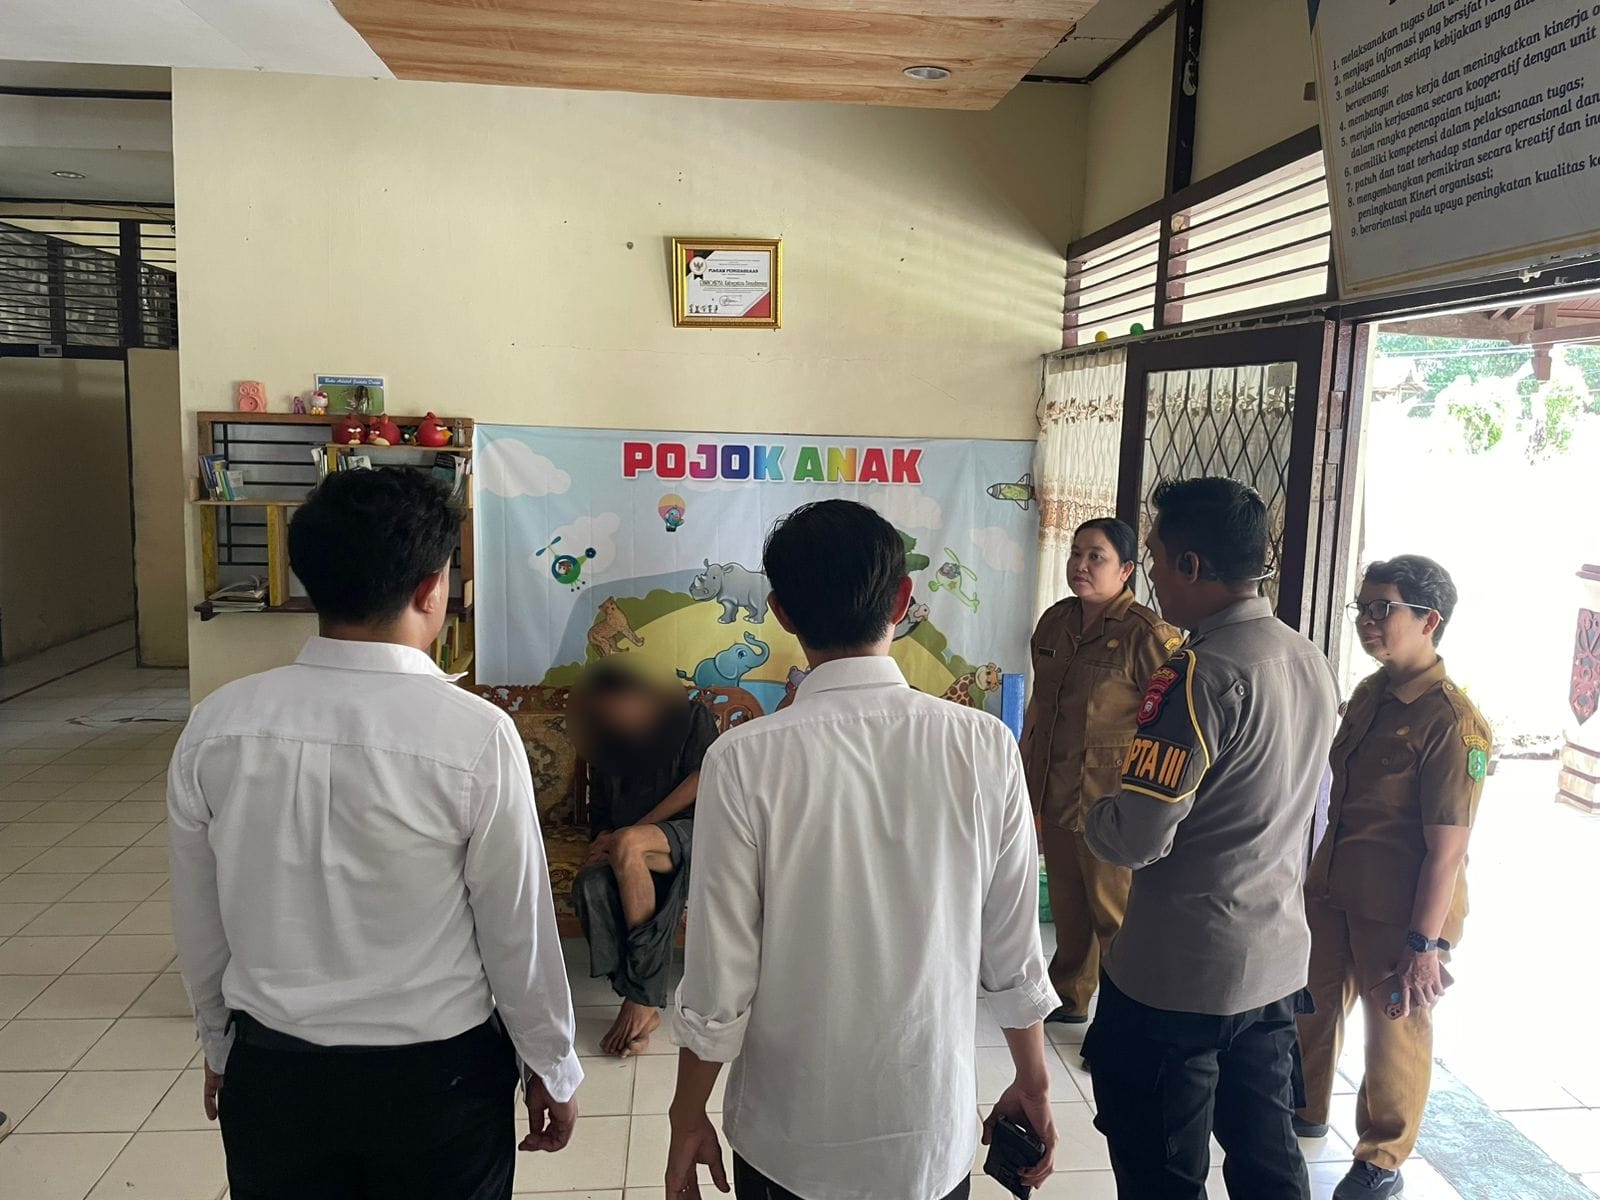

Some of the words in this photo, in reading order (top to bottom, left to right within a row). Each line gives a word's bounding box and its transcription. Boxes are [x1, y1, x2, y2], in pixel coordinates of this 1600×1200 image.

[1341, 26, 1399, 66] melaksanakan
[1400, 11, 1425, 32] tugas
[1427, 1, 1446, 18] dan
[1342, 58, 1375, 82] menjaga
[1376, 32, 1417, 63] informasi
[1418, 21, 1441, 43] yang
[1443, 0, 1482, 27] bersifat
[1344, 60, 1402, 97] melaksanakan
[1403, 45, 1432, 66] setiap
[1434, 20, 1482, 51] kebijakan
[1484, 5, 1511, 28] yang
[1347, 100, 1394, 128] membangun
[1396, 90, 1414, 105] etos
[1415, 78, 1440, 97] kerja
[1441, 69, 1461, 84] dan
[1463, 32, 1541, 75] meningkatkan
[1544, 9, 1590, 38] kinerja
[1345, 84, 1389, 113] berwenang;
[1349, 121, 1383, 144] menjalin
[1384, 102, 1430, 128] kerjasama
[1431, 87, 1464, 108] secara
[1465, 57, 1522, 93] kooperatif
[1523, 41, 1567, 68] dengan
[1569, 25, 1598, 48] unit
[1351, 142, 1375, 159] dalam
[1377, 129, 1407, 146] rangka
[1408, 105, 1462, 138] pencapaian
[1464, 89, 1501, 112] tujuan;
[1353, 149, 1387, 175] memiliki
[1388, 131, 1438, 160] kompetensi
[1440, 122, 1471, 141] dalam
[1473, 93, 1544, 131] pelaksanaan
[1546, 77, 1585, 100] tugas;
[1355, 172, 1378, 192] patuh
[1379, 167, 1395, 180] dan
[1397, 160, 1415, 175] taat
[1417, 143, 1460, 166] terhadap
[1462, 127, 1503, 150] standar
[1505, 99, 1573, 136] operasional
[1575, 92, 1600, 109] dan
[1356, 174, 1424, 204] mengembangkan
[1426, 157, 1475, 183] pemikiran
[1477, 143, 1512, 164] secara
[1515, 125, 1555, 151] kreatif
[1557, 120, 1582, 136] dan
[1358, 196, 1407, 222] peningkatan
[1409, 184, 1437, 203] Kineri
[1439, 166, 1493, 194] organisasi;
[1360, 210, 1408, 235] berorientasi
[1409, 205, 1432, 223] pada
[1434, 197, 1464, 214] upaya
[1466, 176, 1532, 207] peningkatan
[1535, 160, 1586, 184] kualitas
[623, 441, 784, 481] POJOK
[793, 445, 923, 484] ANAK
